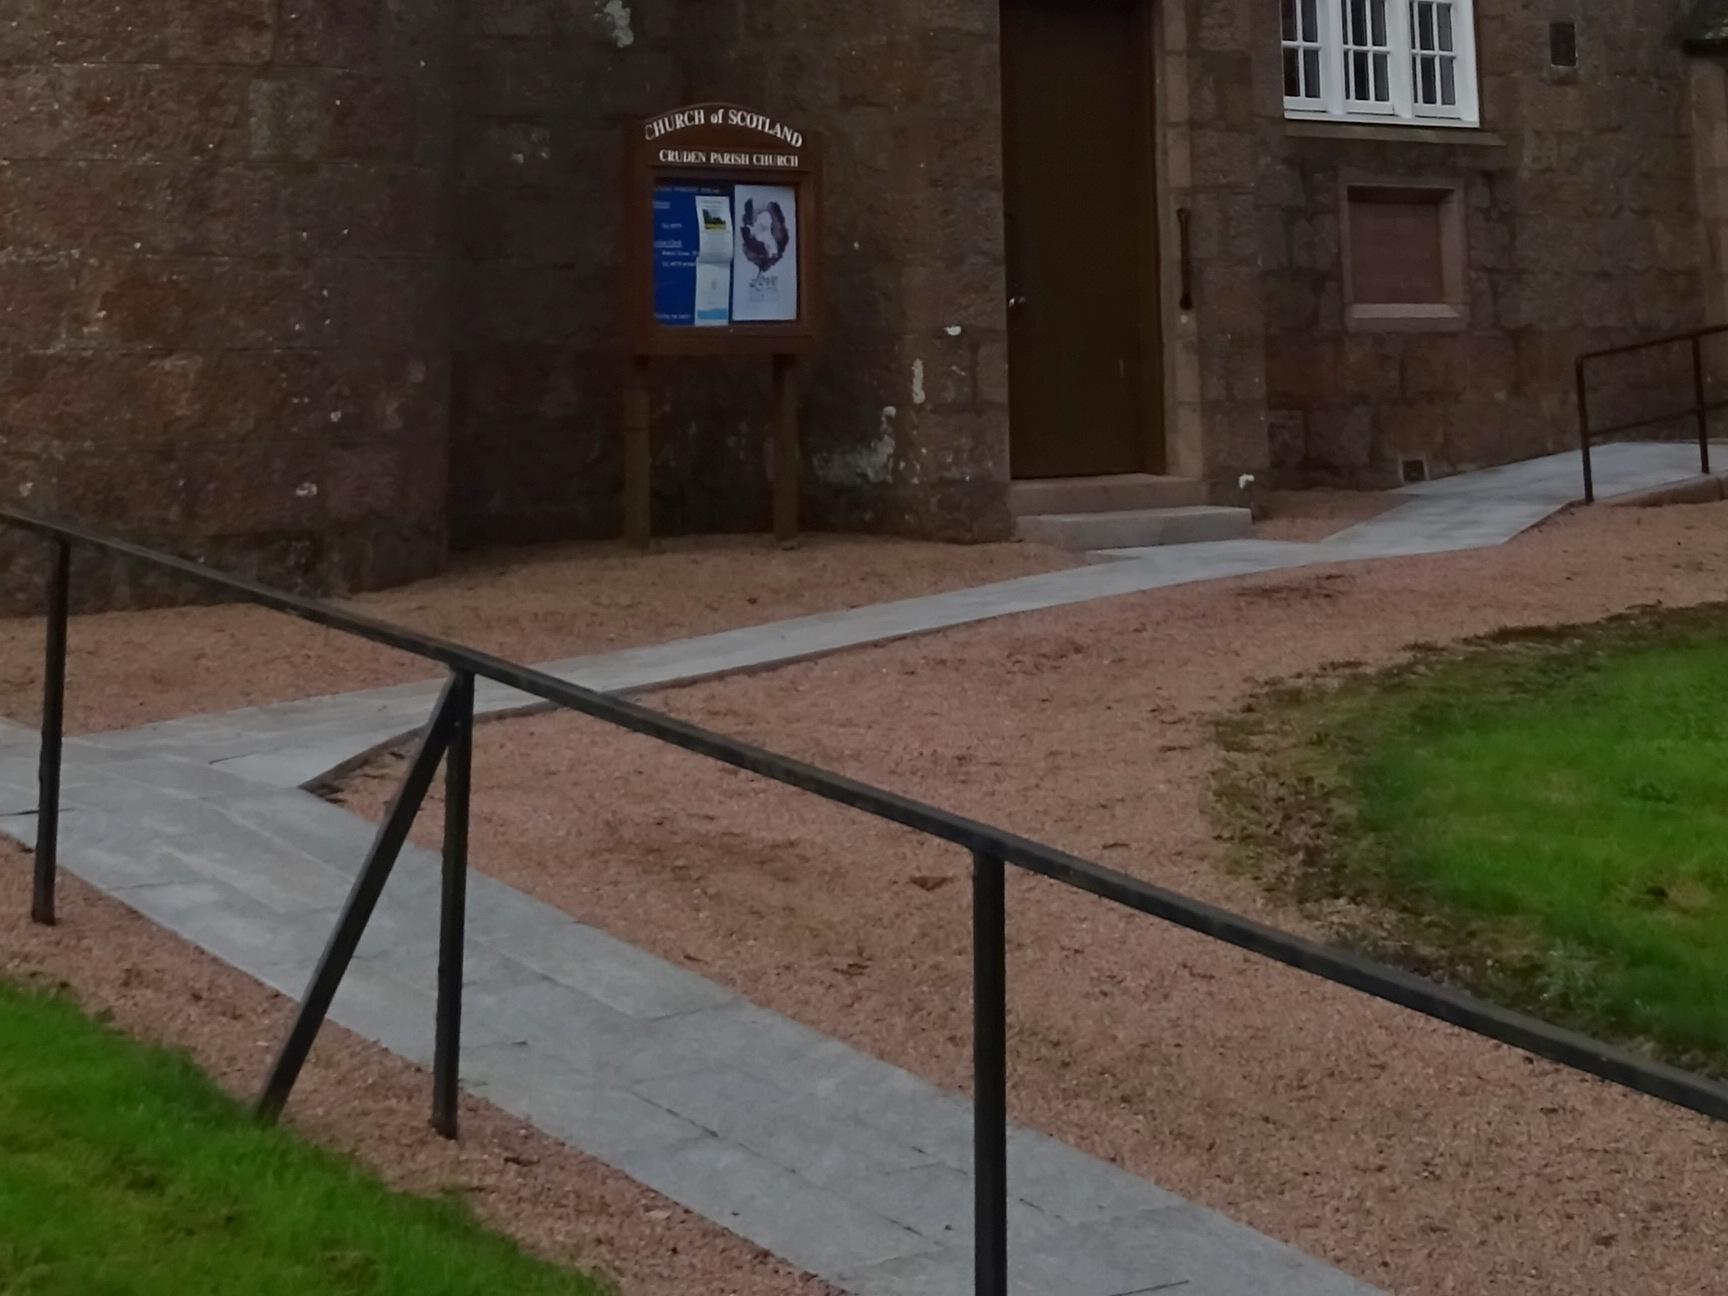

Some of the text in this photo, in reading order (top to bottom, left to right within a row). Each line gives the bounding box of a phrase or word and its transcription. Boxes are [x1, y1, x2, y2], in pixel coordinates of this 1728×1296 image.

[644, 109, 803, 148] CHURCH of SCOTLAND
[659, 149, 799, 167] CRUDEN PARISH CHURCH
